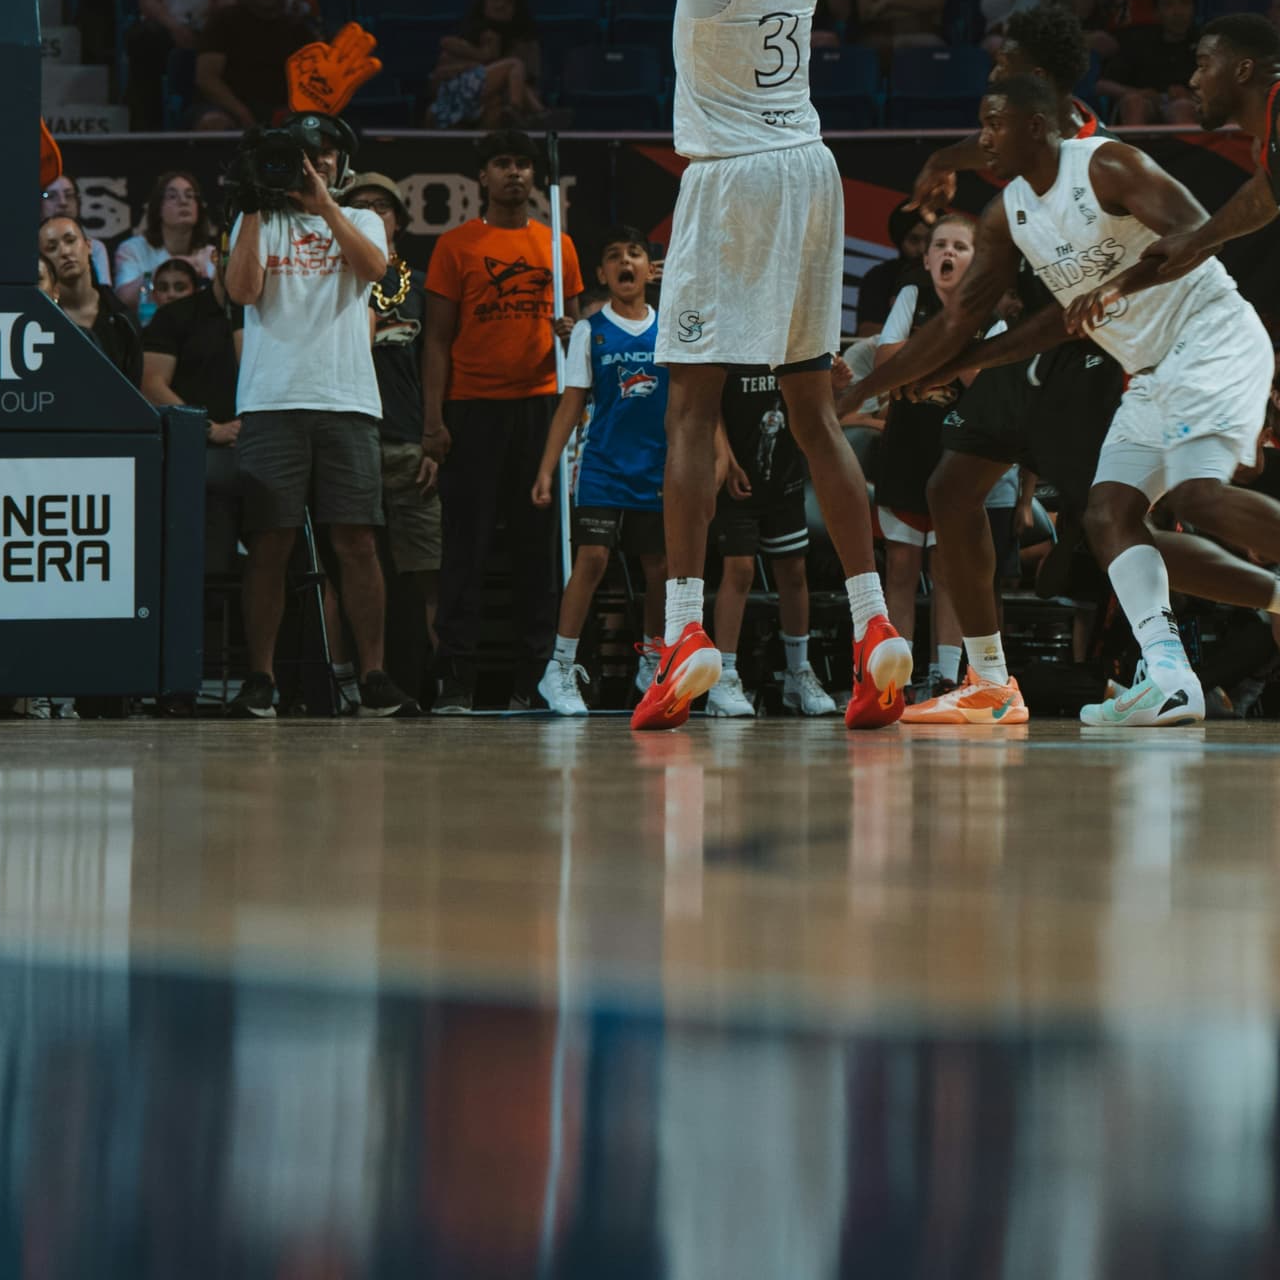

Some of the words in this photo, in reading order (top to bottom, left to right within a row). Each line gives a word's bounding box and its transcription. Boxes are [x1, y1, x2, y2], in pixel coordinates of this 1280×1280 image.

[754, 11, 802, 89] 3
[474, 300, 554, 314] BANDIT
[600, 351, 654, 366] BANDI
[741, 376, 782, 394] TERR
[4, 494, 110, 536] NEW
[3, 541, 110, 582] ERA
